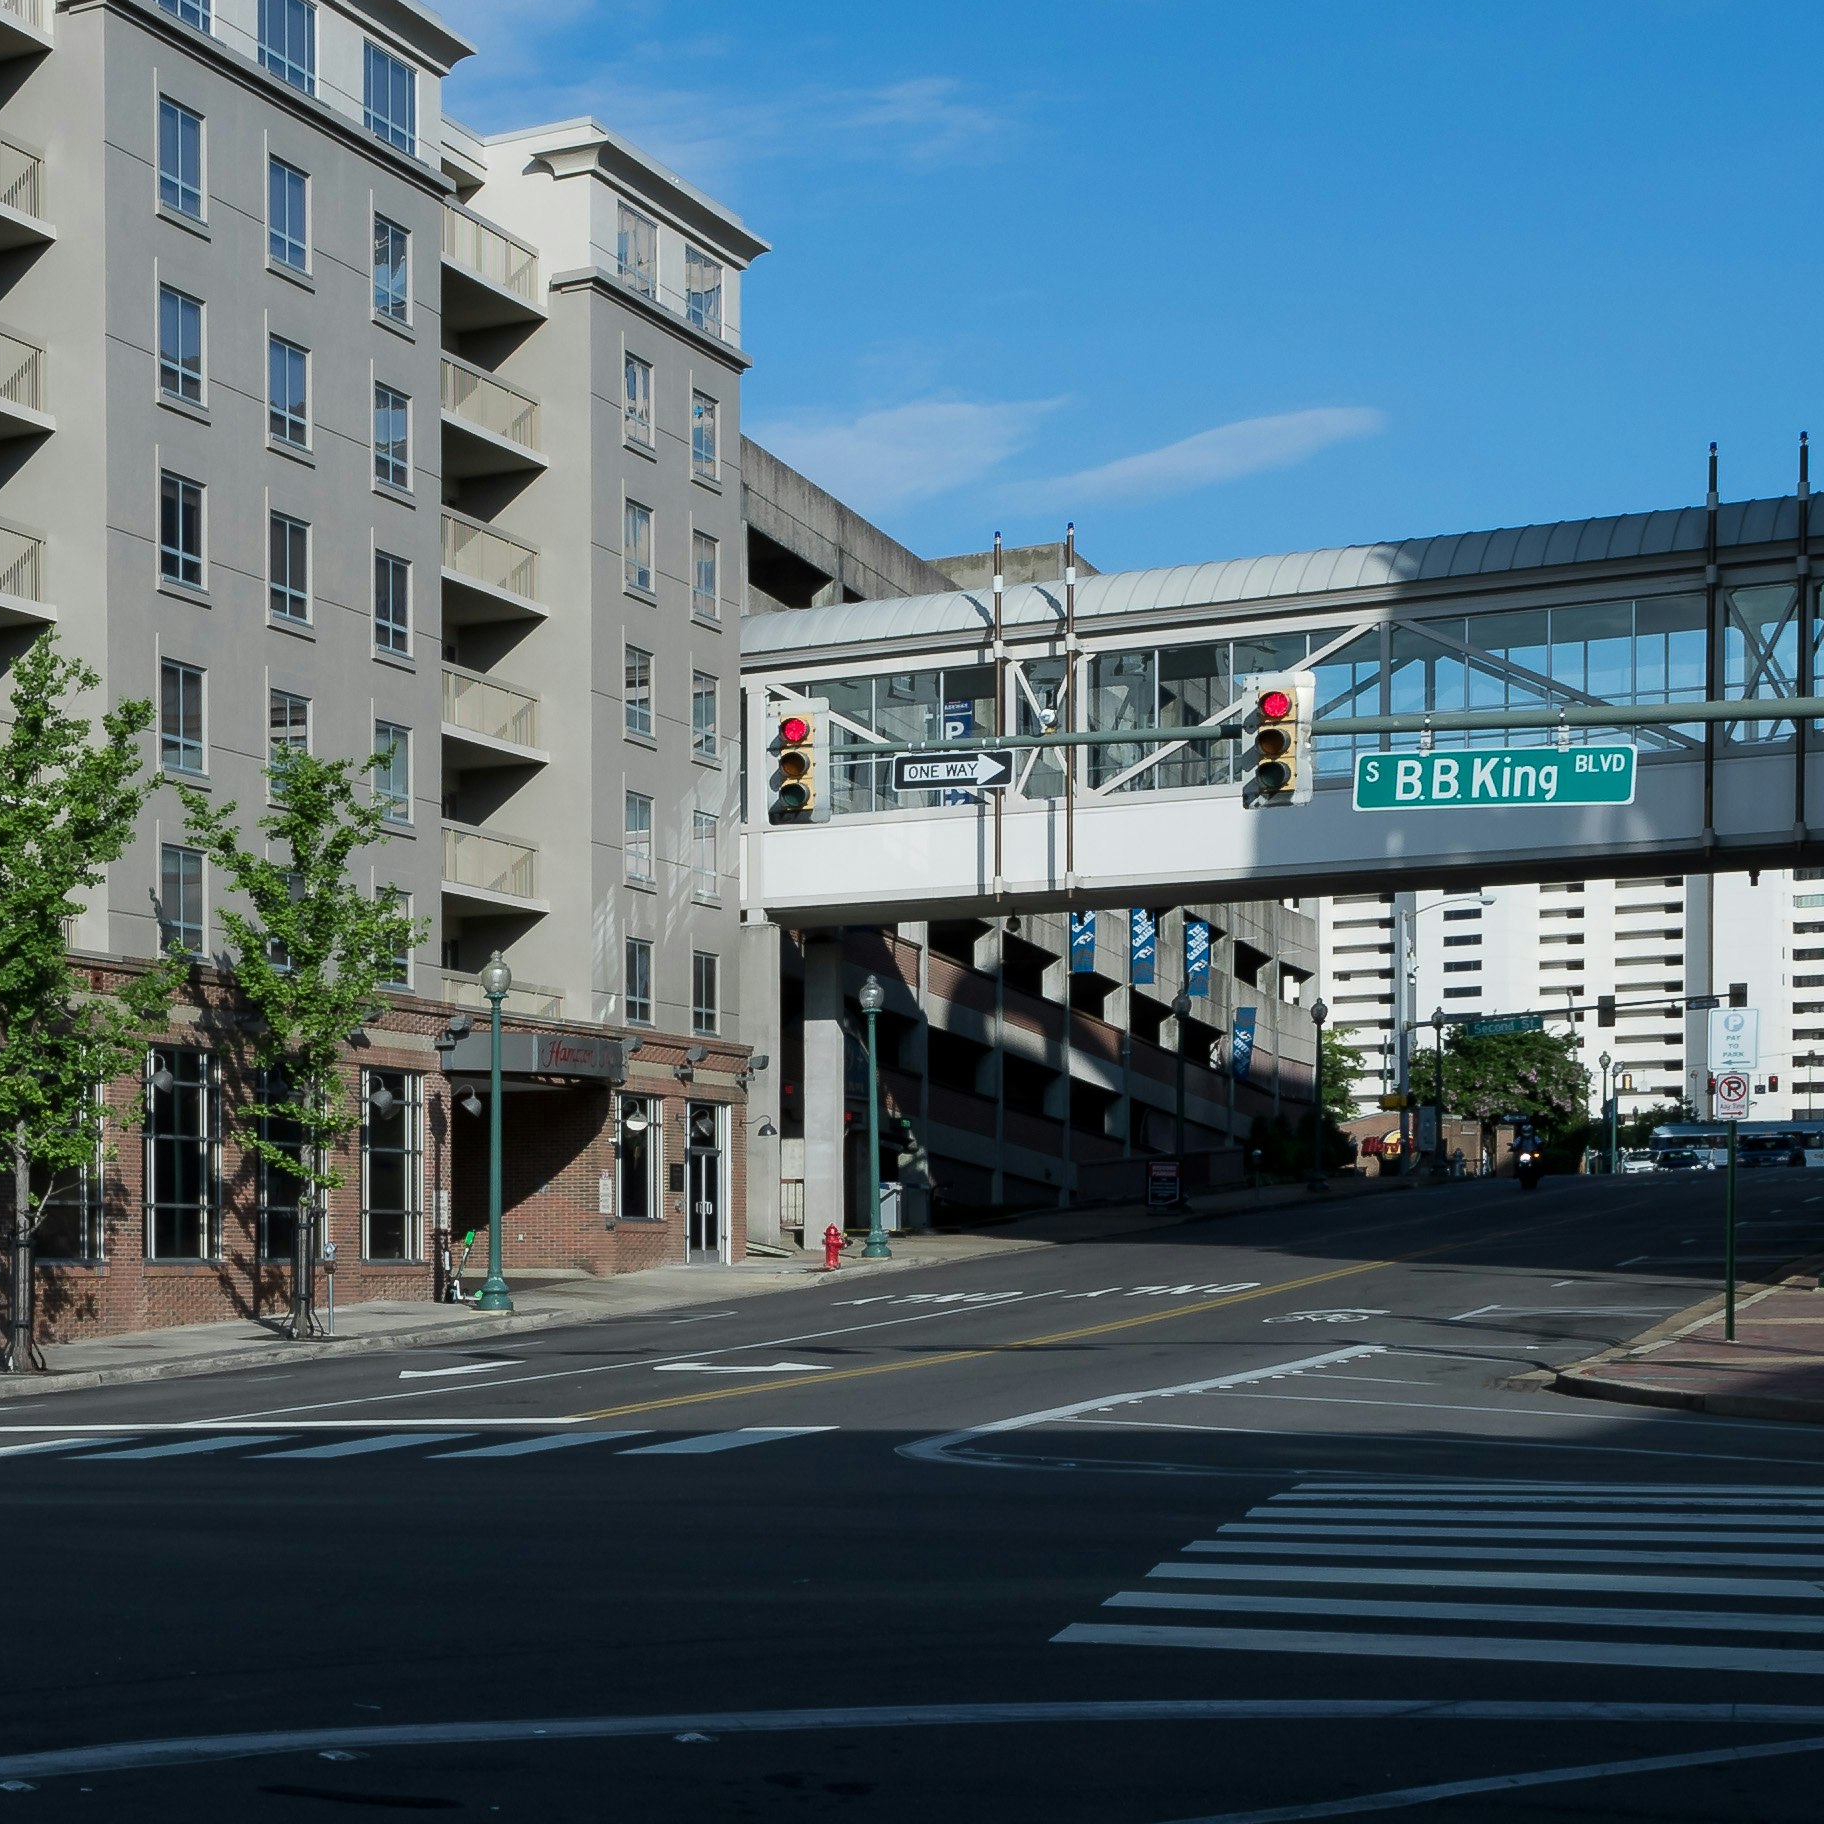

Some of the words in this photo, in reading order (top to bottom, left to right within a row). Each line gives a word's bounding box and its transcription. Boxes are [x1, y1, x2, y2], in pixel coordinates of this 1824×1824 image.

[908, 764, 940, 780] ONE
[946, 762, 978, 777] WAY
[1365, 761, 1380, 782] S
[1471, 756, 1558, 801] King
[1574, 753, 1626, 774] BLVD
[1473, 1022, 1514, 1035] Second
[540, 1039, 597, 1069] Hampton
